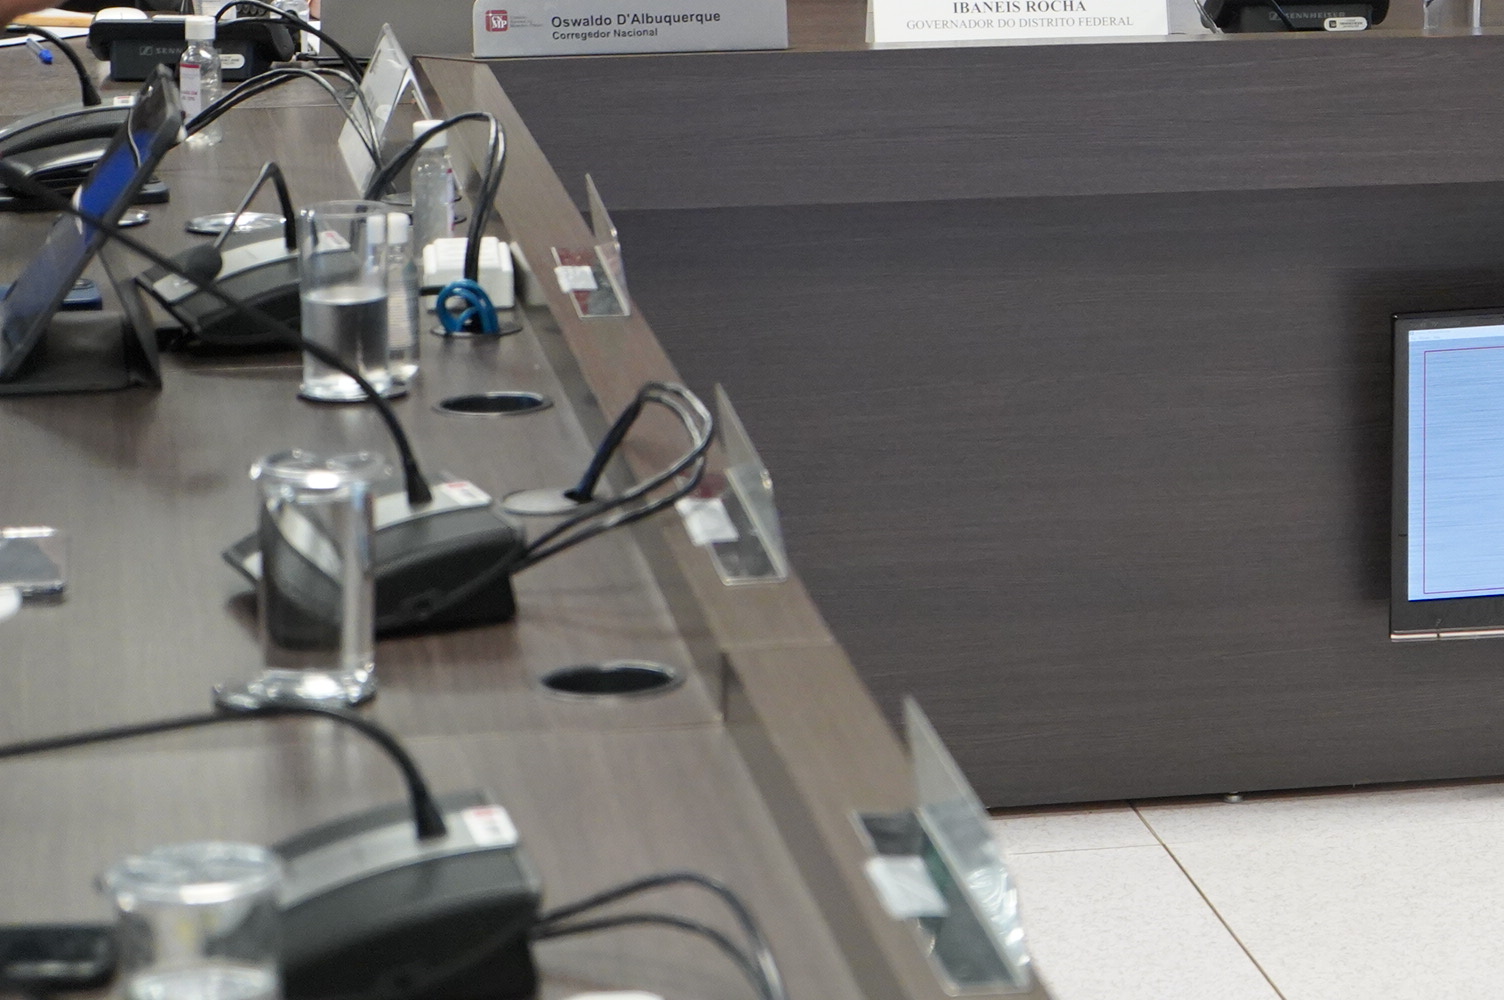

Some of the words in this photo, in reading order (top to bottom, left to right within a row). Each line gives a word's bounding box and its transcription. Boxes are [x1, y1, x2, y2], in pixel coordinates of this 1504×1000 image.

[953, 1, 1020, 14] IBANEIS
[1026, 0, 1087, 12] ROCHA
[551, 15, 612, 28] Oswaldo
[617, 12, 721, 26] D'Albuquerque
[906, 19, 994, 30] GOVERNADOR
[998, 18, 1016, 29] DO
[1019, 17, 1075, 28] DISTRITO
[1078, 16, 1134, 27] FEDERAL
[552, 30, 611, 41] Corregedor
[613, 28, 658, 38] Nacional
